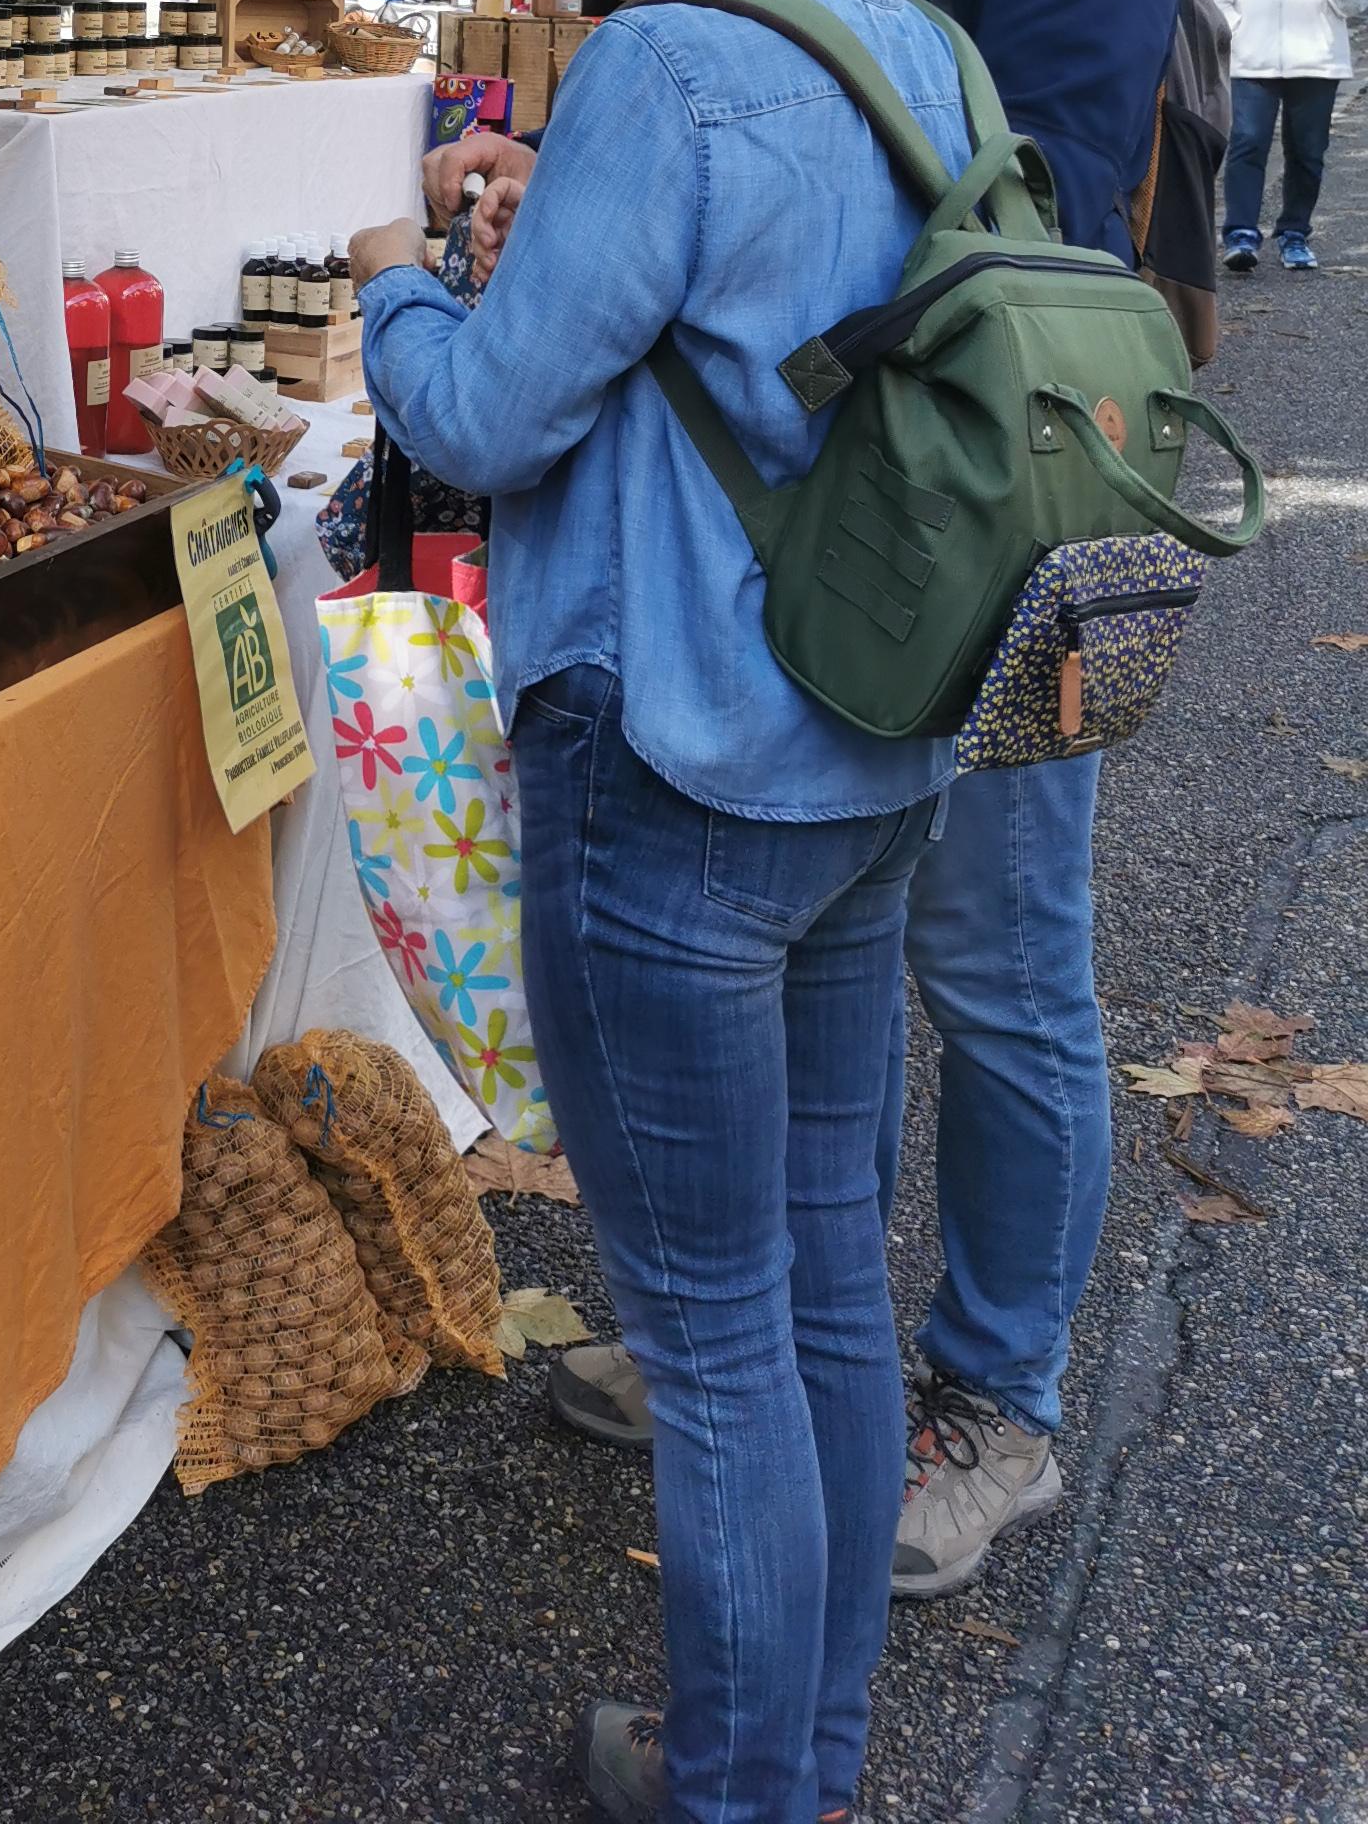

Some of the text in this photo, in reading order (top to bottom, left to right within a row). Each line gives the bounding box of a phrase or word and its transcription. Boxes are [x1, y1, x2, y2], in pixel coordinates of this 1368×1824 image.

[187, 505, 250, 567] CHÂTAIGNES
[233, 626, 267, 705] AB
[235, 689, 280, 728] AGRICULTURE
[238, 705, 283, 743] BIOLOGIQUE
